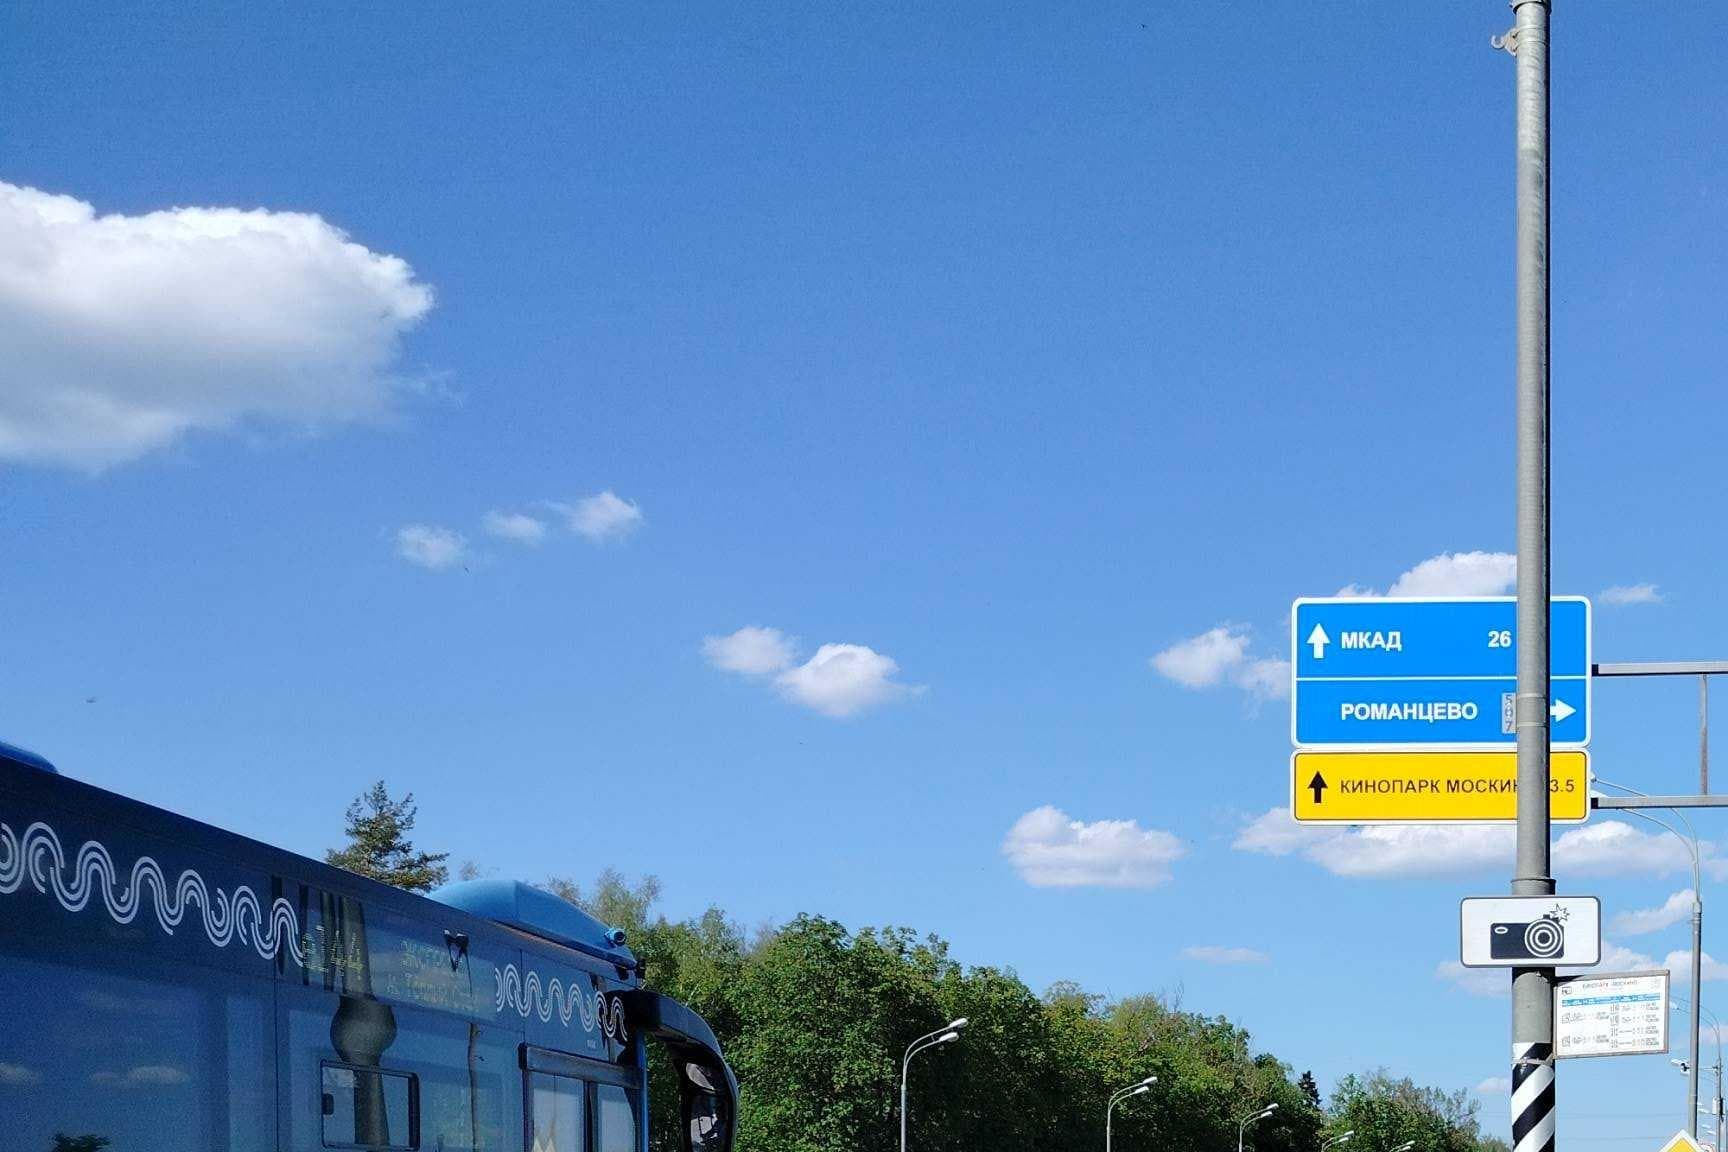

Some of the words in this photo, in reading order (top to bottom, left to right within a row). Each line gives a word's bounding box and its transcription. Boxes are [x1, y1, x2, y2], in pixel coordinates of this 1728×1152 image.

[1341, 631, 1402, 651] МКАД
[1487, 630, 1512, 648] 26
[1341, 702, 1478, 723] РОМАНЦЕВО
[1340, 779, 1441, 794] КИНОПАРК
[1550, 778, 1575, 793] 3.5
